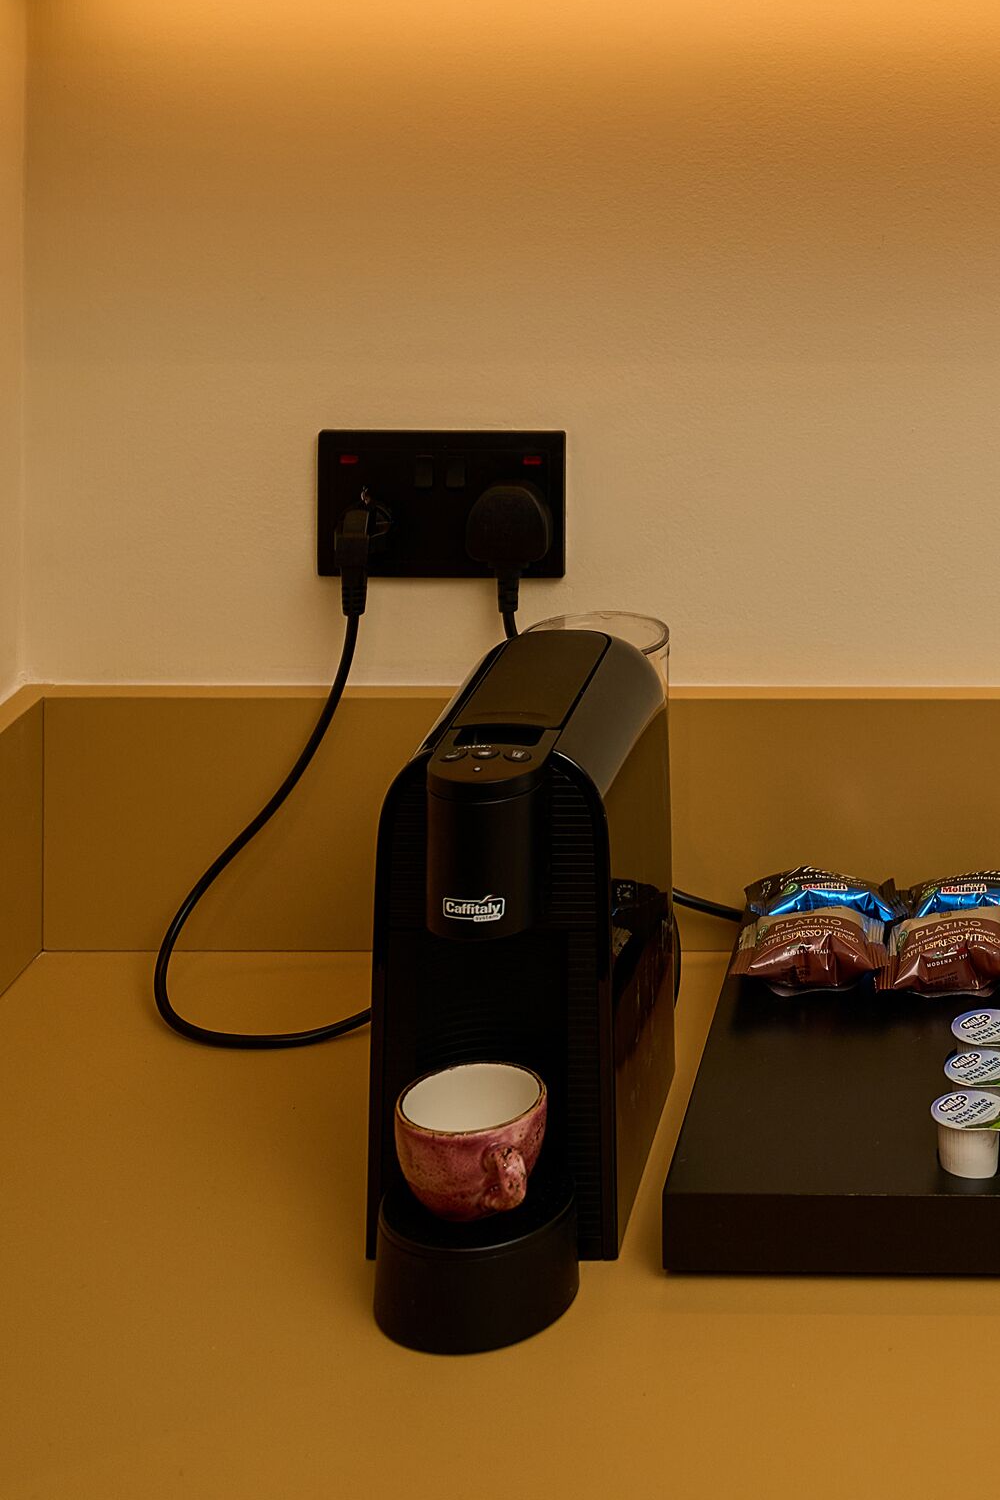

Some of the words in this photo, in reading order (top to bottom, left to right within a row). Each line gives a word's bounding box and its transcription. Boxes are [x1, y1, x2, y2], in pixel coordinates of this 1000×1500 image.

[942, 885, 985, 893] Molinari
[446, 901, 501, 915] Caffitaly
[775, 918, 842, 931] PLATINO
[915, 920, 981, 940] PLATINO
[783, 930, 822, 941] ESPRESSO
[924, 934, 964, 951] ESPRESSO
[926, 958, 952, 968] MODENA
[966, 1026, 992, 1038] tastes
[973, 1031, 996, 1041] fresh
[957, 1066, 984, 1078] tastes
[982, 1057, 999, 1067] like
[965, 1071, 988, 1081] fresh
[946, 1109, 973, 1121] tastes
[970, 1098, 987, 1109] like
[955, 1114, 978, 1124] fresh
[977, 1101, 995, 1114] milk
